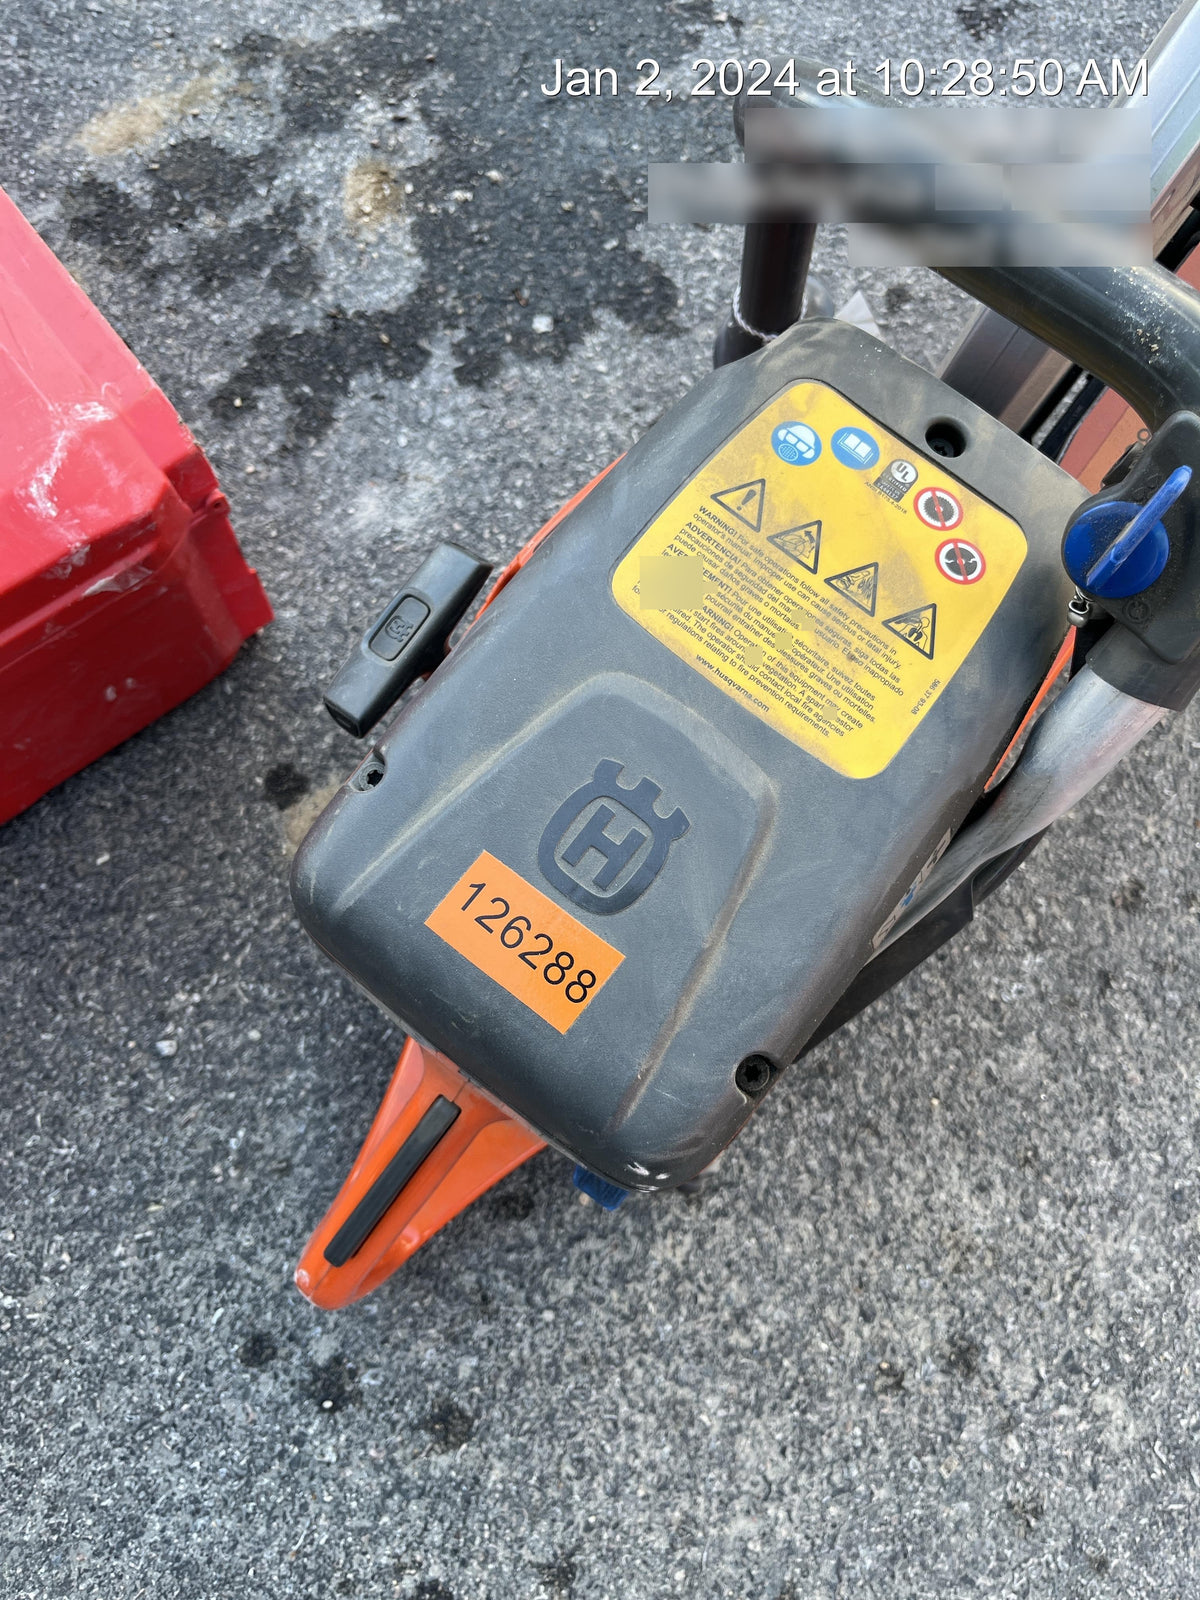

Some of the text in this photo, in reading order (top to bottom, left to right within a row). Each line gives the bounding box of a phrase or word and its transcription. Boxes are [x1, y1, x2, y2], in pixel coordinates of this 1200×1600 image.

[896, 462, 909, 481] UL
[673, 534, 697, 553] puede
[695, 550, 719, 569] causar
[718, 566, 741, 585] daños
[739, 583, 764, 604] graves
[678, 527, 779, 603] precauciones de seguridad del
[684, 520, 742, 565] ADVERTENCIA!
[740, 561, 758, 577] Para
[756, 573, 785, 597] obtener
[823, 624, 854, 649] seguras,
[852, 645, 870, 661] siga
[868, 657, 890, 675] todas
[888, 671, 901, 683] las
[690, 512, 726, 541] operator's
[751, 556, 784, 582] Improper
[782, 580, 797, 592] use
[796, 590, 810, 602] can
[809, 599, 831, 617] cause
[830, 614, 857, 636] serious
[856, 634, 865, 643] or
[864, 639, 882, 654] fatal
[879, 651, 902, 670] injury.
[697, 505, 897, 655] WARNING! For safe operations follow all safety precautions in
[664, 612, 704, 643] regulations
[701, 639, 729, 663] relating
[728, 658, 737, 667] to
[736, 663, 750, 676] fire
[747, 673, 785, 703] prevention
[783, 700, 832, 738] requirements.
[691, 619, 708, 634] The
[705, 630, 736, 656] operator
[757, 669, 784, 692] contact
[783, 688, 802, 704] local
[800, 701, 814, 713] fire
[692, 609, 710, 625] start
[708, 621, 725, 636] fires
[798, 688, 806, 697] A
[693, 653, 771, 713] www.husqvarna.com
[704, 593, 733, 616] pourrait
[731, 612, 763, 638] entraîner
[762, 635, 777, 648] des
[807, 671, 833, 692] graves
[832, 688, 843, 698] ou
[715, 590, 744, 613] sécurité
[742, 610, 753, 620] du
[825, 671, 842, 686] Une
[840, 682, 875, 710] utilisation
[731, 590, 749, 606] Pour
[747, 604, 762, 617] une
[830, 665, 854, 685] suivez
[852, 681, 876, 701] toutes
[766, 653, 776, 663] of
[775, 660, 789, 673] this
[787, 670, 826, 701] equipment
[839, 709, 864, 729] create
[862, 663, 905, 697] inapropiado
[461, 882, 597, 1004] 126288
